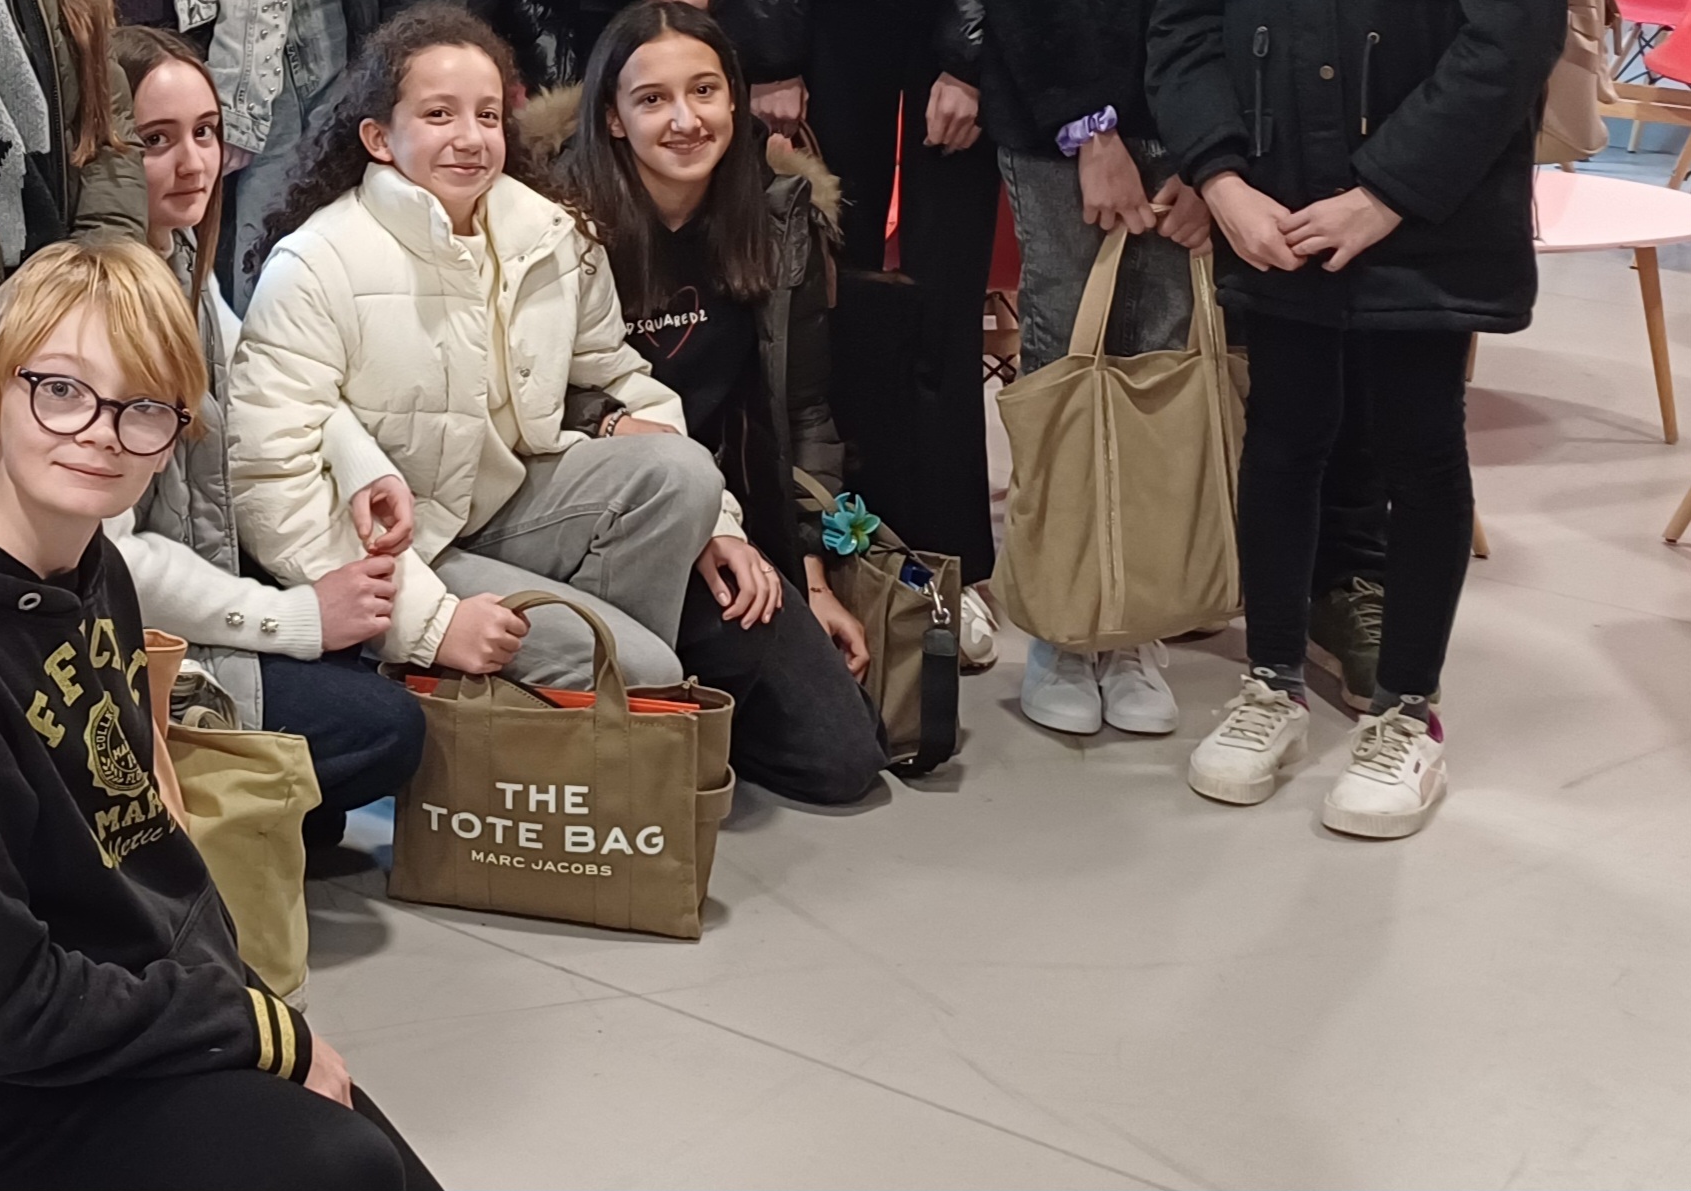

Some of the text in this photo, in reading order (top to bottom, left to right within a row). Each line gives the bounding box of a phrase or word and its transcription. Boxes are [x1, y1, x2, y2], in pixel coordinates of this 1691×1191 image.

[625, 308, 708, 336] DSQUARED2
[495, 781, 590, 814] THE
[421, 802, 665, 855] TOTE BAG
[470, 849, 613, 877] MARC JACOBS
